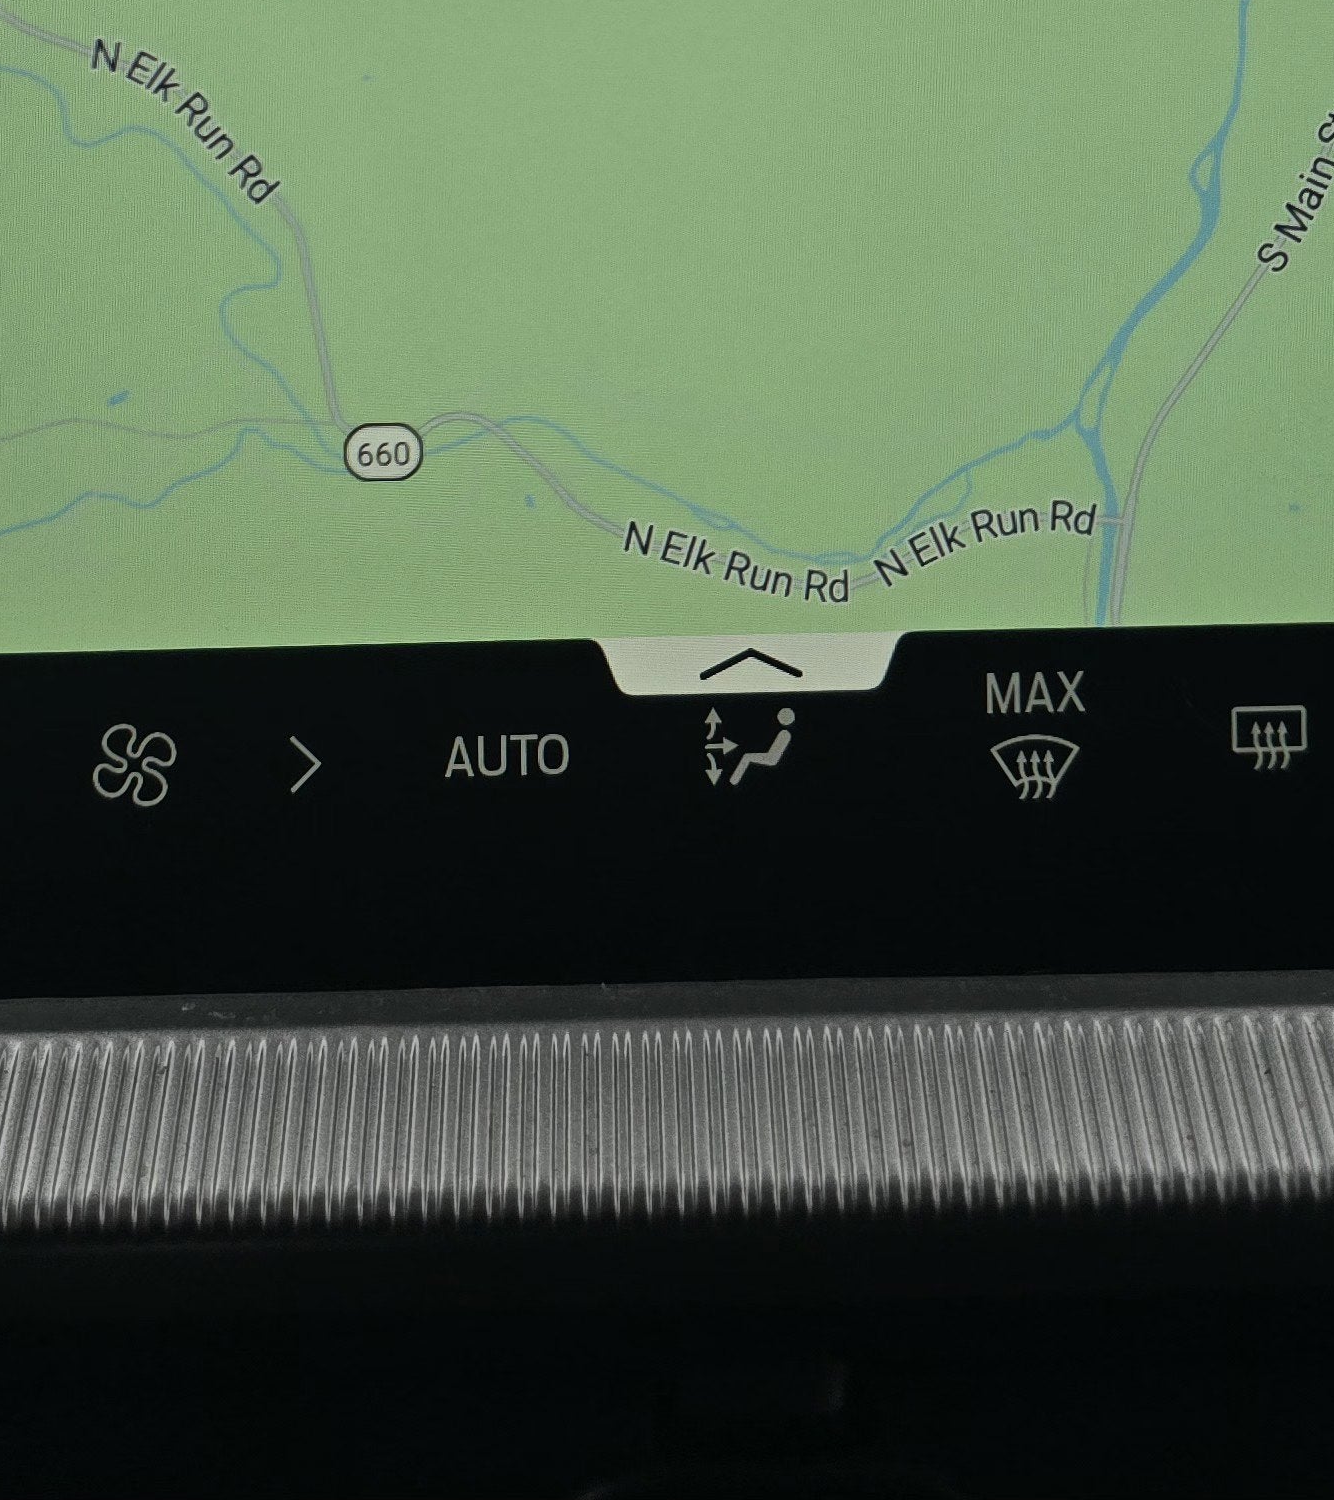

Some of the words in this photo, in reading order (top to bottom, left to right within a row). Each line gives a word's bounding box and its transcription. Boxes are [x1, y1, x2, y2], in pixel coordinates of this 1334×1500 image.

[91, 38, 122, 72] N
[126, 51, 180, 102] Elk
[174, 92, 234, 160] Run
[228, 154, 281, 204] Rd
[1257, 243, 1288, 272] S
[357, 441, 411, 468] 660
[623, 521, 655, 556] N
[660, 530, 716, 575] Elk
[723, 550, 793, 598] Run
[804, 569, 849, 602] Rd
[874, 548, 909, 587] N
[908, 525, 966, 568] Elk
[971, 505, 1041, 543] Run
[1050, 500, 1098, 536] Rd
[985, 669, 1087, 716] MAX
[443, 732, 570, 779] AUTO
